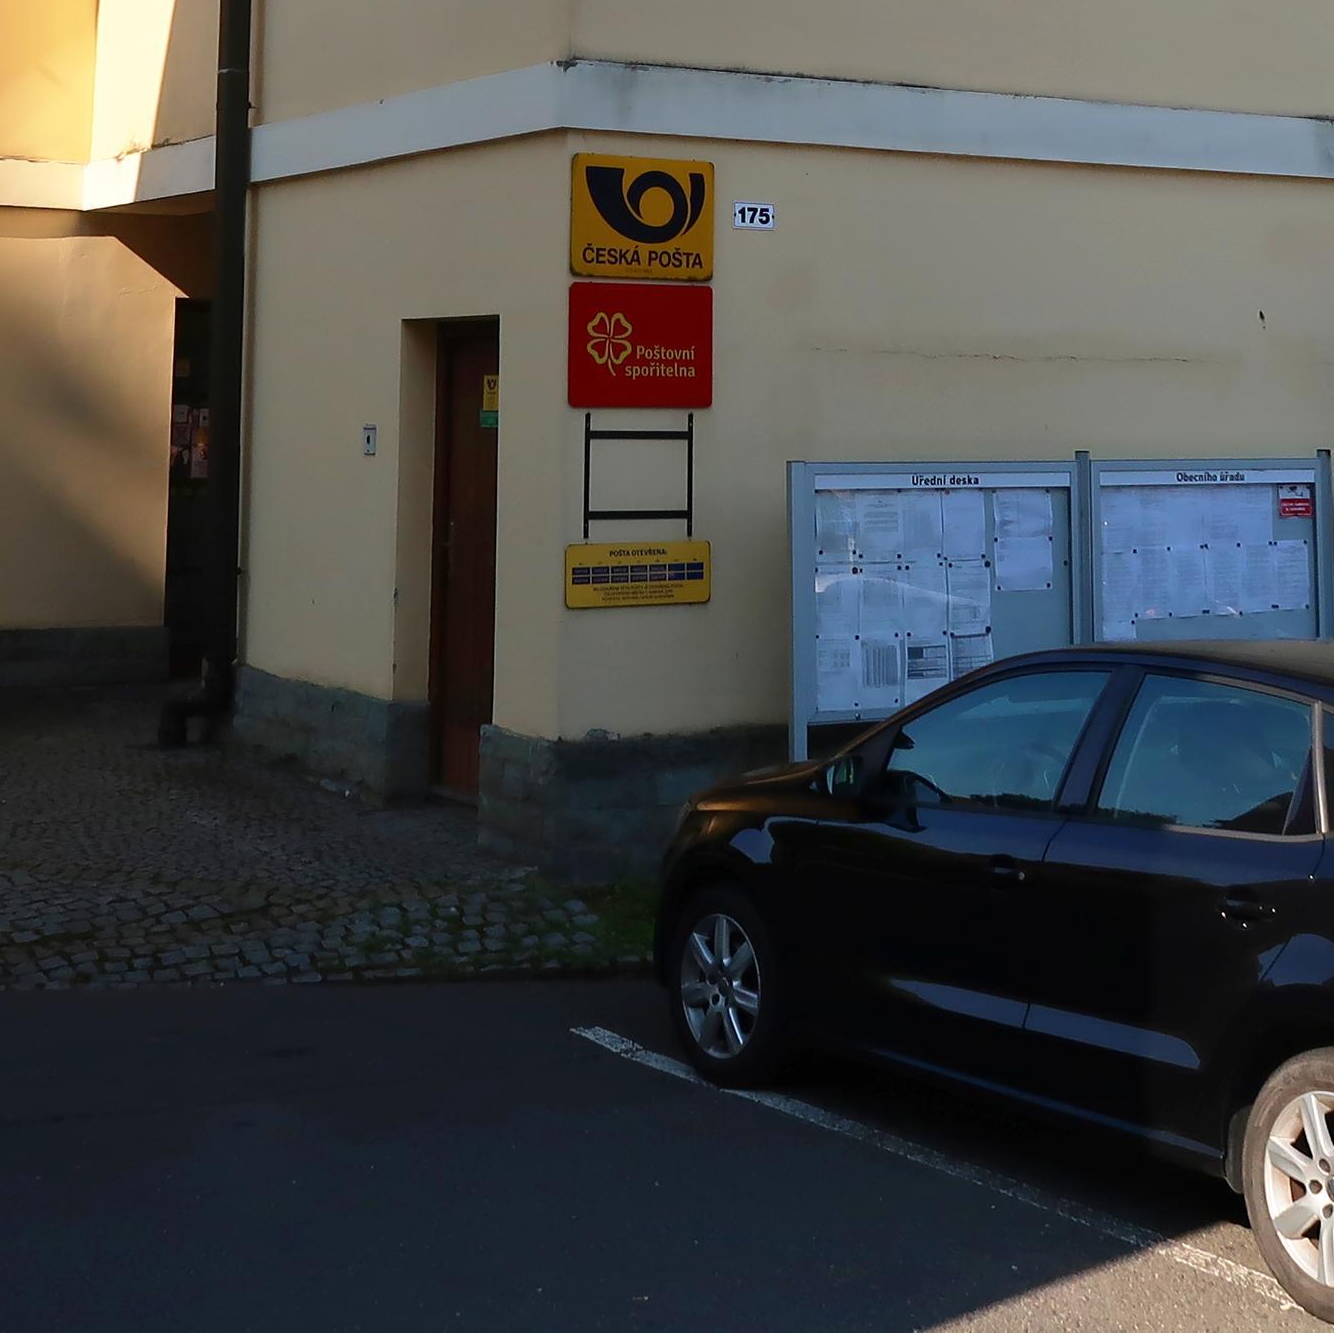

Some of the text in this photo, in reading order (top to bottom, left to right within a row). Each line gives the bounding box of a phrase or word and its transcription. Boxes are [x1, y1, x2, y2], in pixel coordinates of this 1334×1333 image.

[738, 207, 770, 224] 175
[582, 243, 703, 268] ČESKÁ POŠTA
[636, 345, 695, 360] Poštovní
[625, 363, 696, 380] spořitelna
[949, 475, 979, 485] deska
